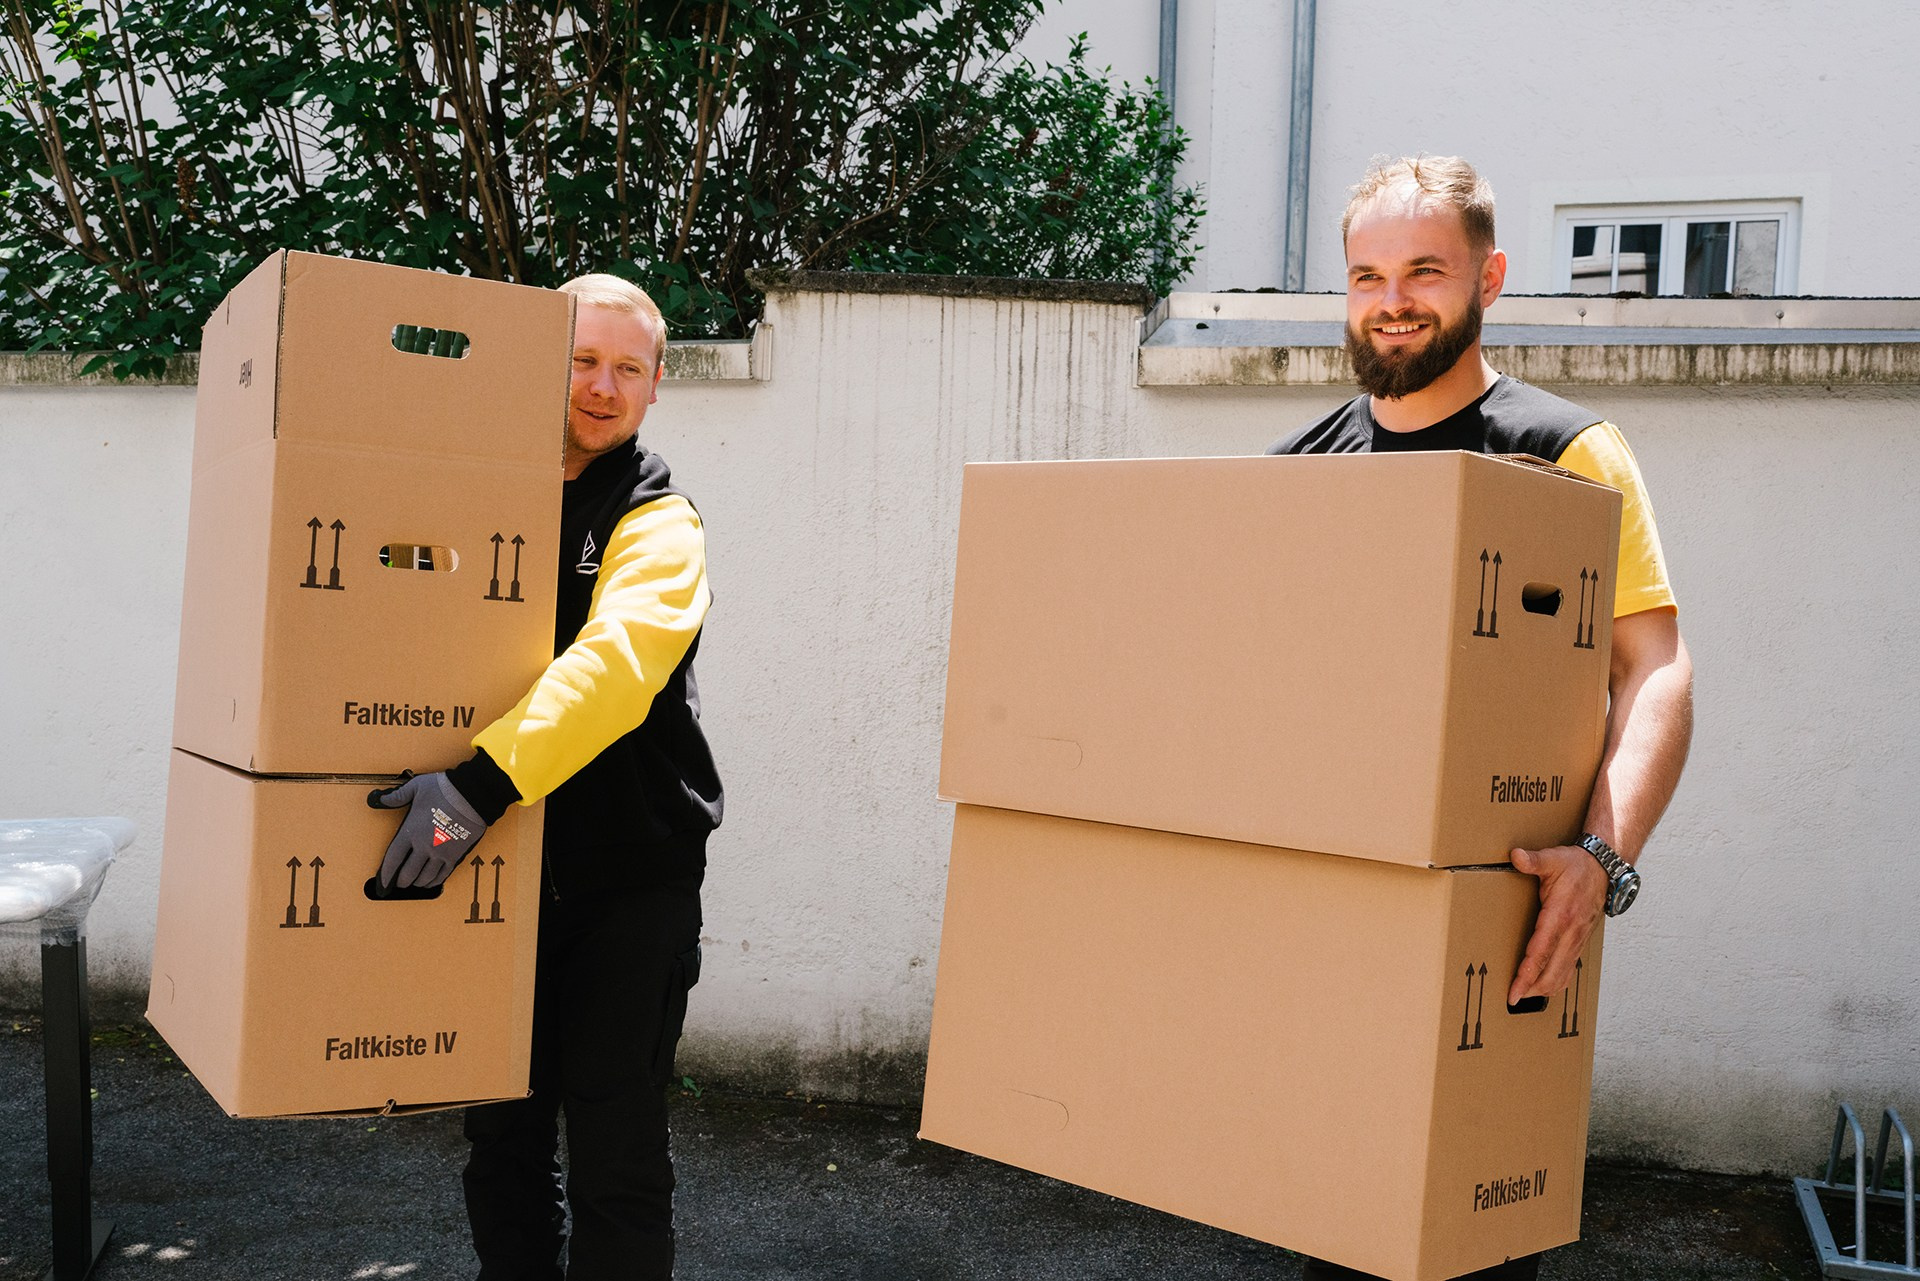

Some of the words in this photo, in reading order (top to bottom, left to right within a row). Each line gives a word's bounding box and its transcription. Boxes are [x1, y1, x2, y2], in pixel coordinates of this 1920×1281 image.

[344, 701, 445, 728] Faltkiste
[452, 706, 475, 728] IV
[1490, 775, 1547, 803] Faltkiste
[1550, 775, 1563, 802] IV
[325, 1034, 427, 1061] Faltkiste
[434, 1031, 457, 1054] IV
[1473, 1174, 1531, 1213] Faltkiste
[1533, 1168, 1547, 1198] IV
